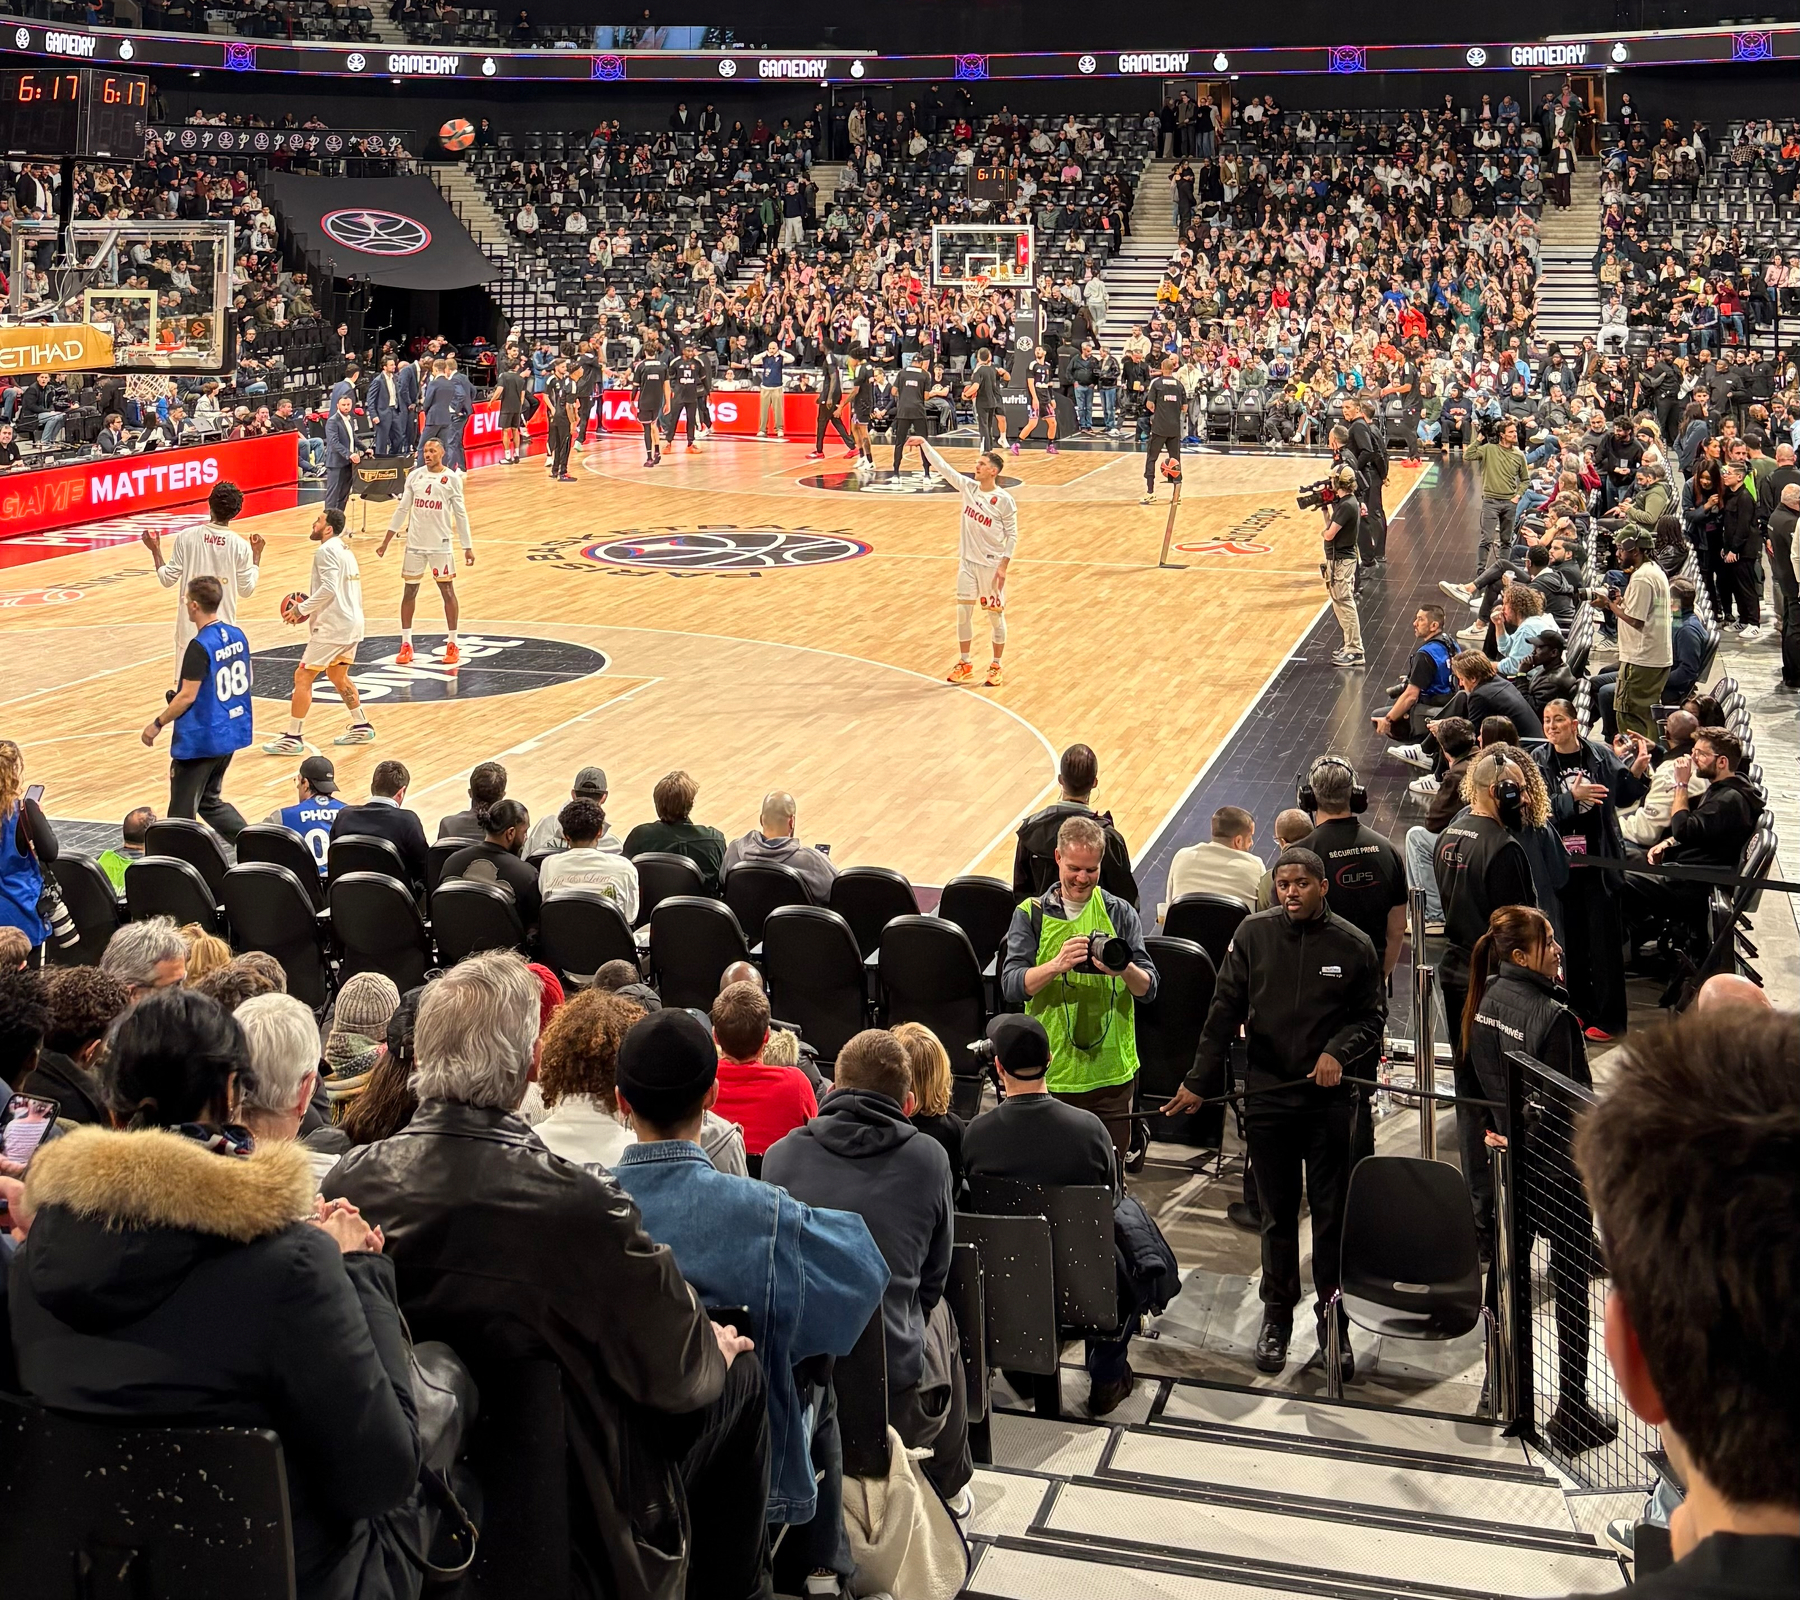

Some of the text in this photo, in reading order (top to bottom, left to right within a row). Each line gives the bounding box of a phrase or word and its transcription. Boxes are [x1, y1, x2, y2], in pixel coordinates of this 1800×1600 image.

[45, 31, 96, 57] GAMEDAY
[388, 55, 459, 74] GAMEDAY
[1118, 53, 1190, 72] GAMEDAY
[1511, 44, 1586, 66] GAMEDAY
[758, 60, 827, 78] GAMEDAY
[18, 75, 78, 102] 6:17
[104, 78, 146, 106] 6:17
[977, 168, 1005, 180] 6:17
[91, 457, 219, 505] MATTERS
[424, 483, 432, 496] 4
[215, 640, 244, 663] PHOTO
[215, 660, 249, 703] 08
[300, 808, 339, 824] PHOT
[1328, 844, 1380, 859] SÉCURITÉ PRIVÉE
